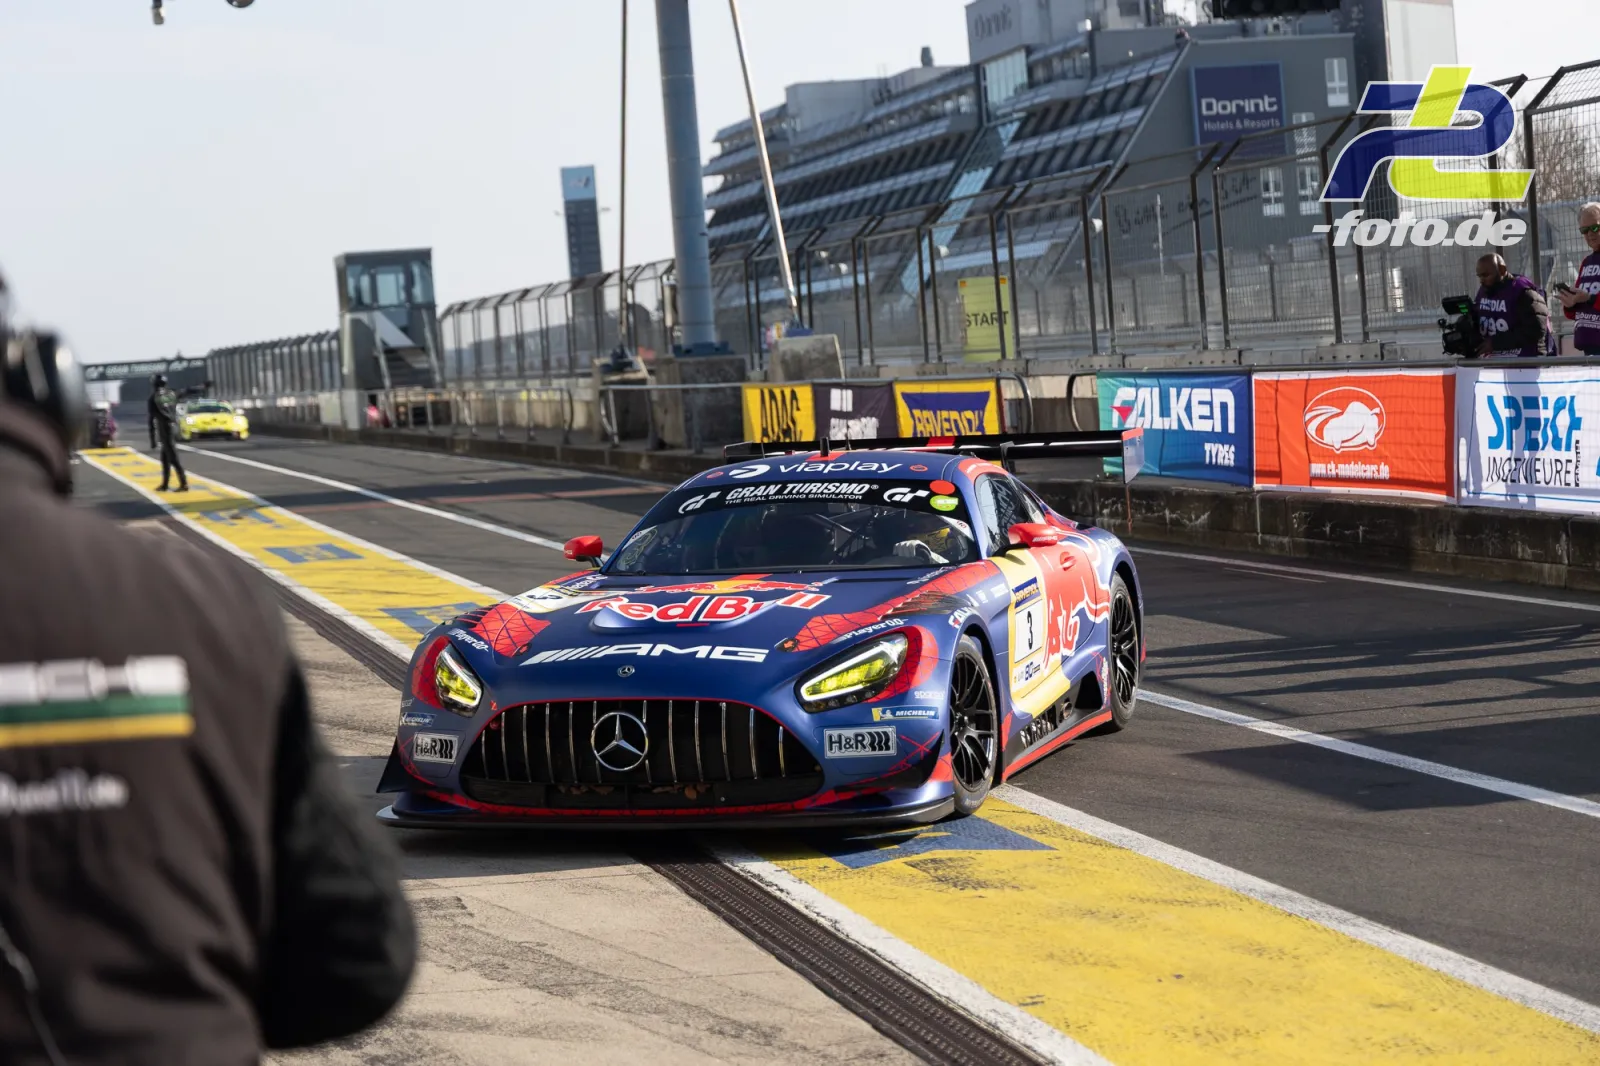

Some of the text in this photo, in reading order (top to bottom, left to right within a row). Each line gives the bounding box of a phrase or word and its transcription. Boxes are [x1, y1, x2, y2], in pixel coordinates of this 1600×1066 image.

[1201, 94, 1278, 116] Dorint
[1203, 118, 1280, 132] Hotels & Resorts
[1480, 297, 1507, 312] MEDIA
[966, 310, 1009, 327] START
[1111, 386, 1236, 434] FALKEN
[1204, 442, 1236, 467] TYRES
[779, 460, 903, 474] viaplay
[1310, 461, 1390, 480] www.ck-modelcars.de
[1486, 456, 1572, 487] INGENIEURE
[725, 485, 783, 500] GRAN
[574, 596, 705, 621] Red
[1027, 610, 1034, 650] 3
[596, 643, 769, 662] AMG
[895, 709, 936, 717] MICHELIN
[415, 735, 438, 757] H&R
[828, 732, 868, 753] H&R
